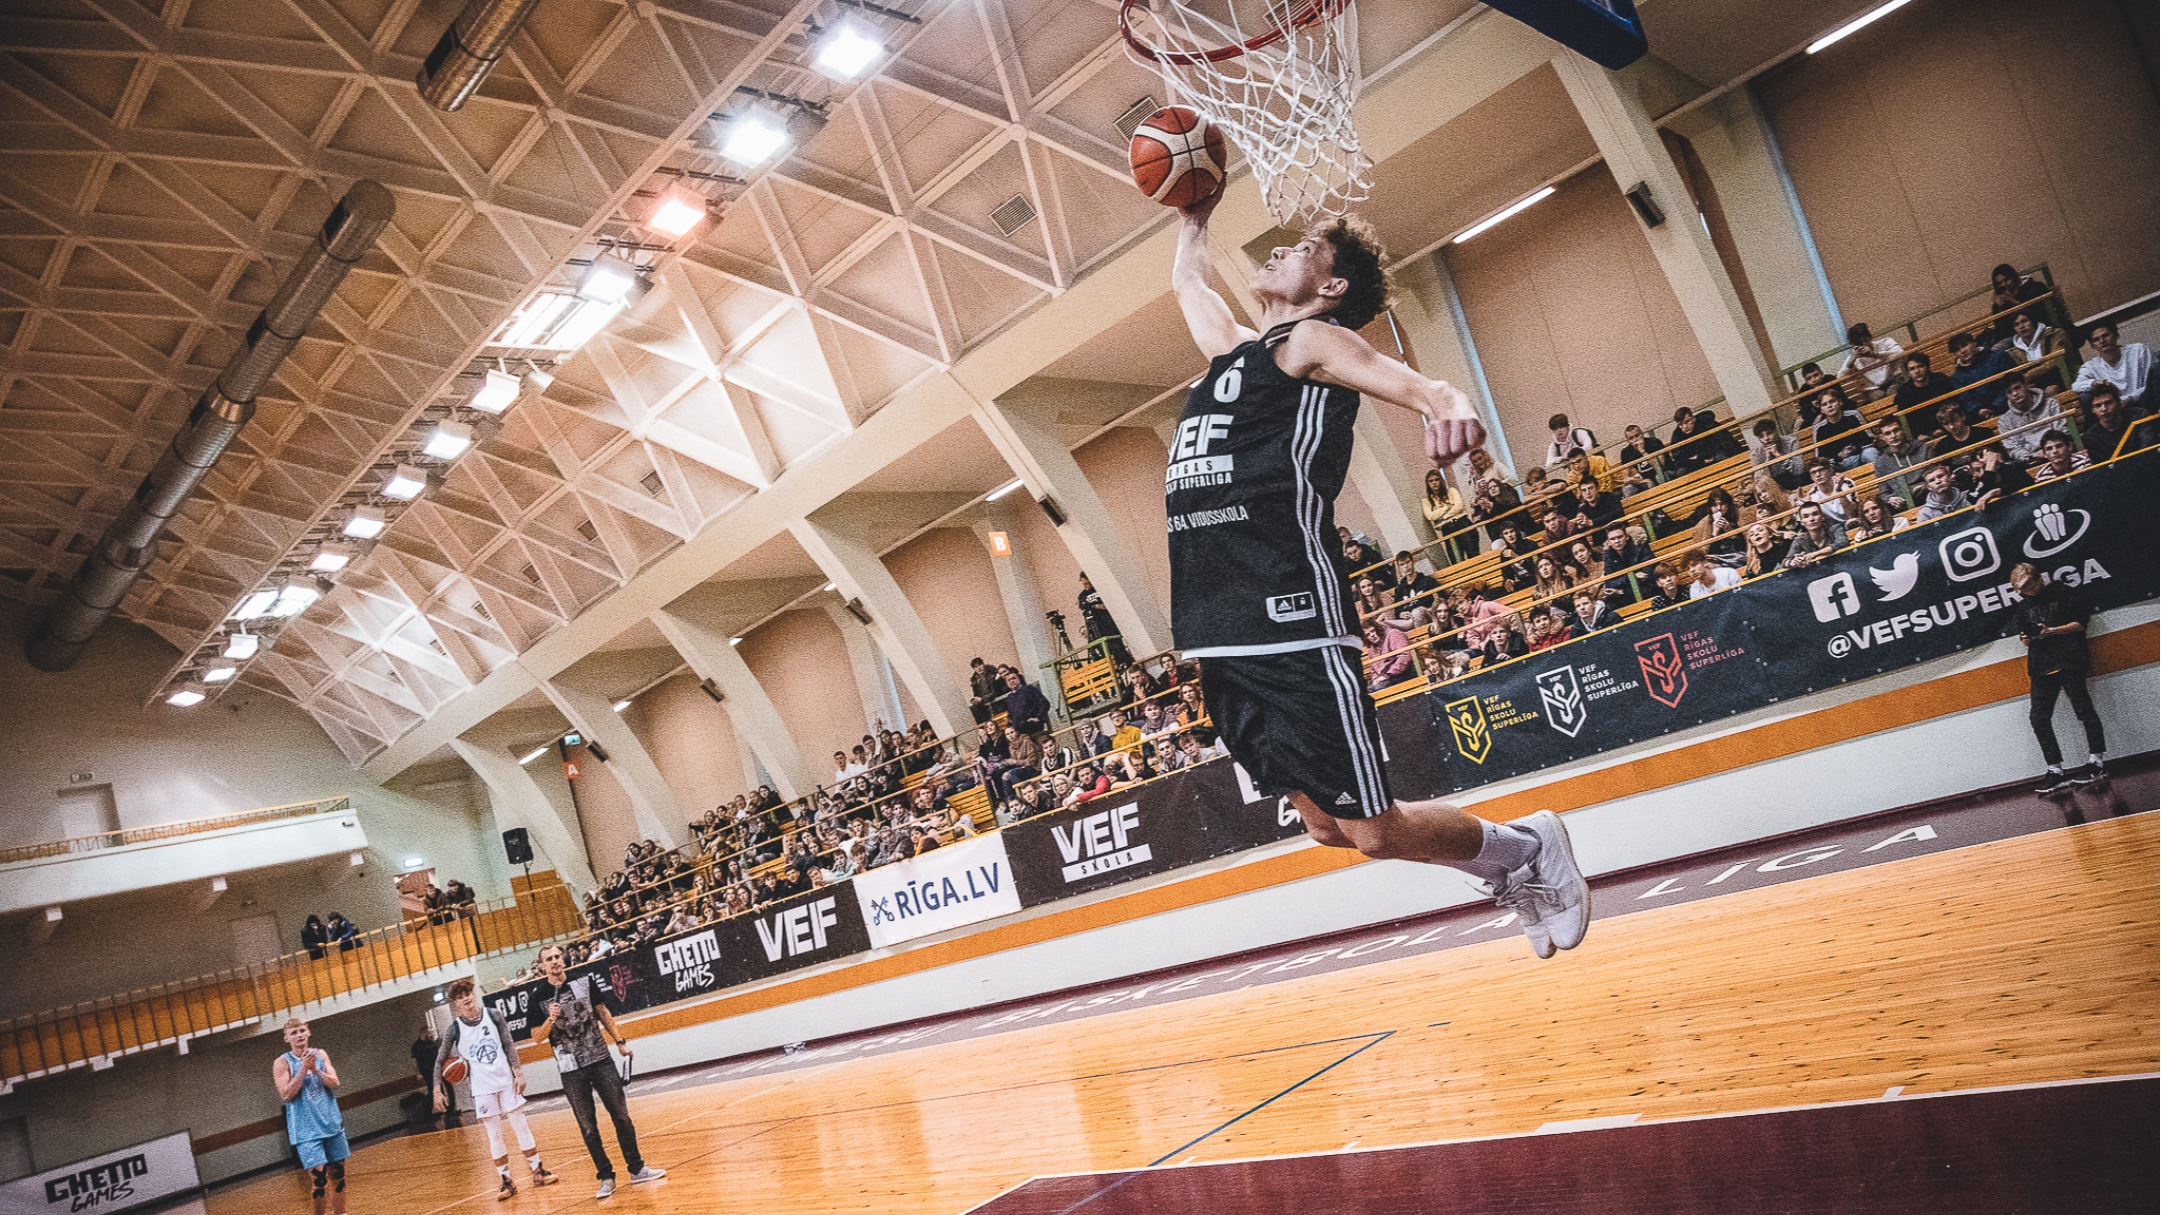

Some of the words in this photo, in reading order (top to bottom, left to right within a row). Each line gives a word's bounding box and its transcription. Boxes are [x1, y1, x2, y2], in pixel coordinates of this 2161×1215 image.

[1213, 356, 1245, 403] 6
[1187, 505, 1250, 528] VIDUSSKOLA
[993, 536, 1006, 551] B
[1680, 630, 1699, 641] VEF
[1686, 645, 1718, 660] SKOLU
[1578, 663, 1597, 675] VEF
[1584, 677, 1615, 693] SKOLU
[1483, 694, 1500, 705] VEF
[1489, 708, 1516, 722] SKOLU
[567, 764, 579, 776] A
[1050, 802, 1140, 864] VEF
[1081, 852, 1134, 876] SKOLA
[894, 862, 999, 919] RĪGA.LV
[754, 895, 838, 962] VEF
[654, 929, 721, 976] GHETTO
[675, 963, 715, 992] GAMES
[482, 1025, 490, 1036] 2
[44, 1153, 148, 1204] GHETTO
[71, 1181, 134, 1213] GAMES
